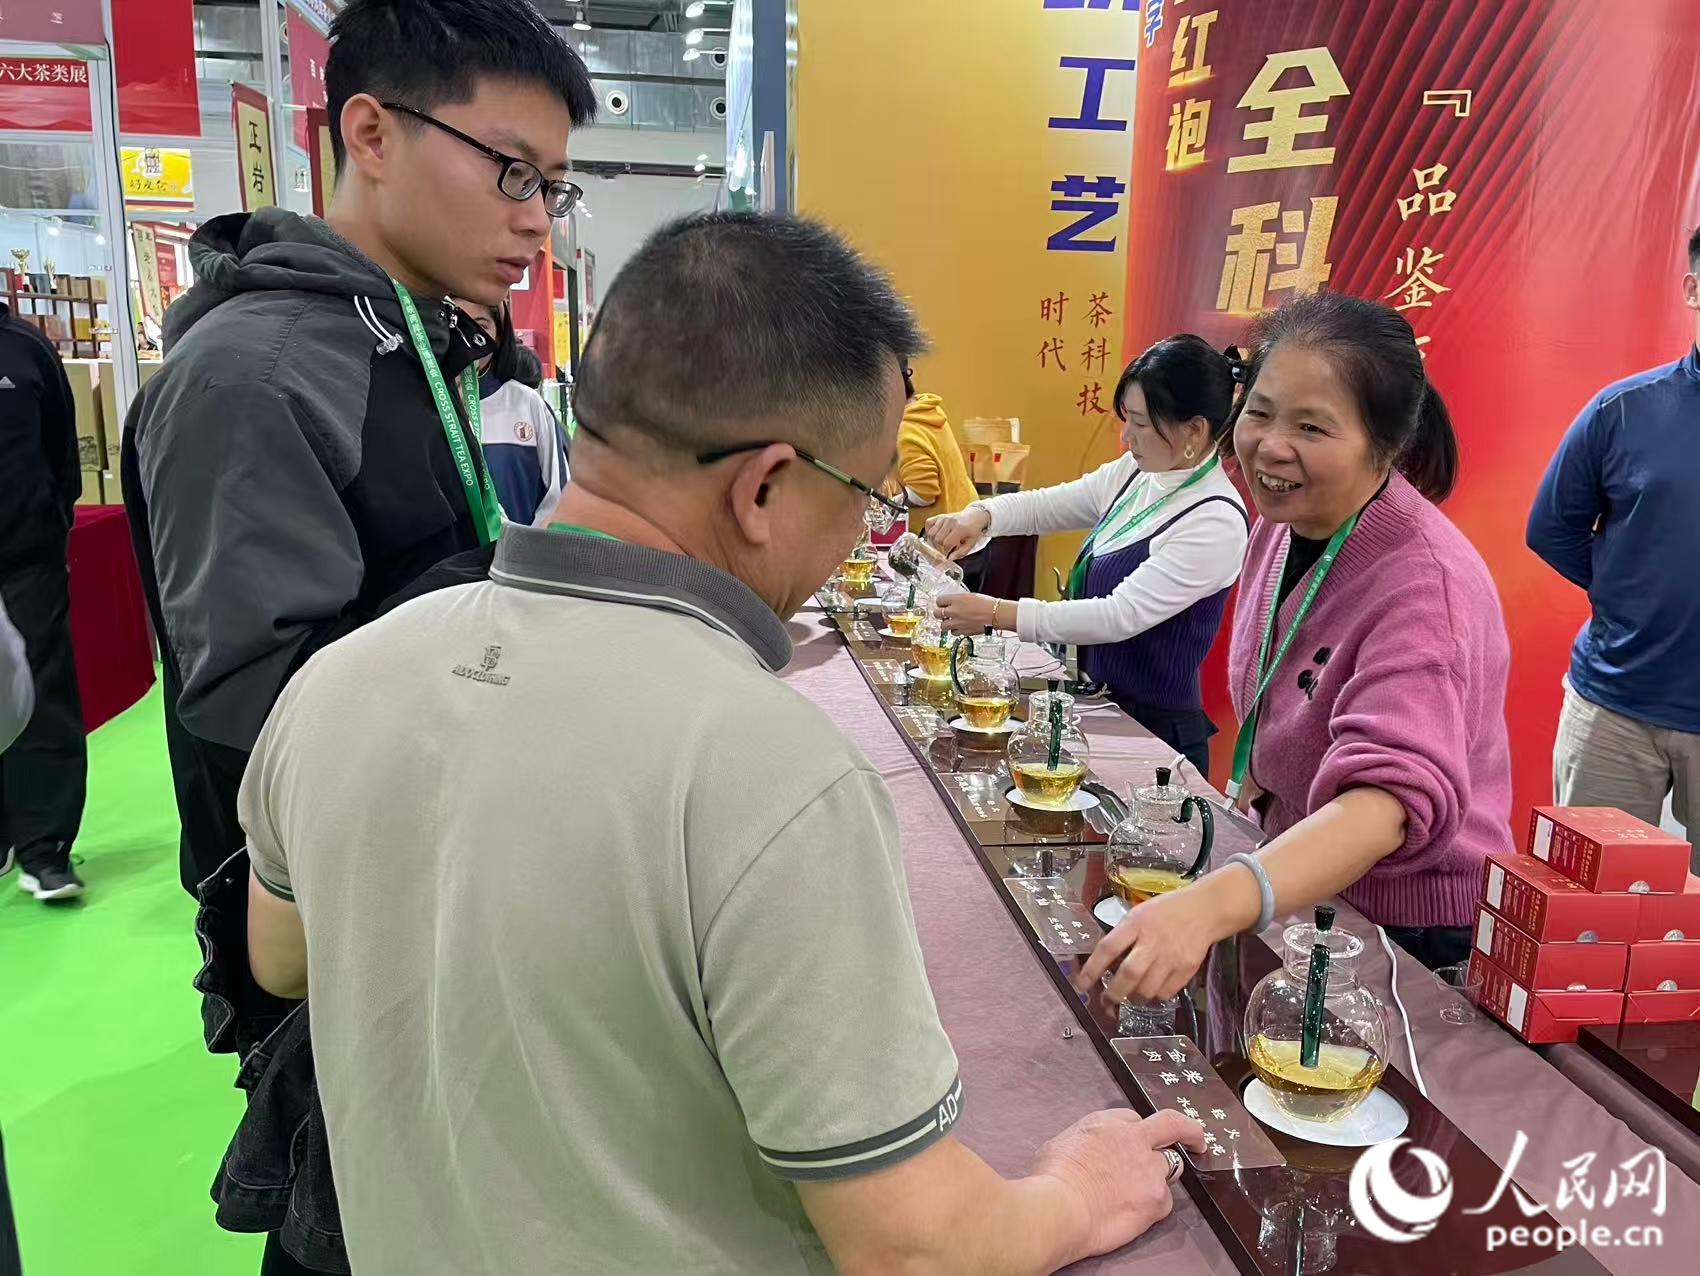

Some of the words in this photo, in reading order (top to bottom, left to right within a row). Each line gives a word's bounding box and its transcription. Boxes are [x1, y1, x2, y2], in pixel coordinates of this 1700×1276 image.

[0, 62, 87, 83] 六大茶类展
[1165, 0, 1219, 171] 红袍
[1043, 0, 1139, 252] 工艺
[1215, 47, 1350, 350] 全科
[1384, 90, 1472, 359] 『品鉴
[1034, 291, 1069, 372] 时代
[1076, 291, 1113, 416] 茶科技
[434, 381, 449, 412] CROSS
[445, 412, 462, 443] STRAIT
[455, 442, 467, 463] TEA
[461, 463, 474, 486] EXPO
[467, 394, 477, 420] CROSS
[1142, 1049, 1180, 1086] 肉桂
[1166, 1048, 1205, 1085] 金奖
[1210, 1107, 1241, 1141] 轻火
